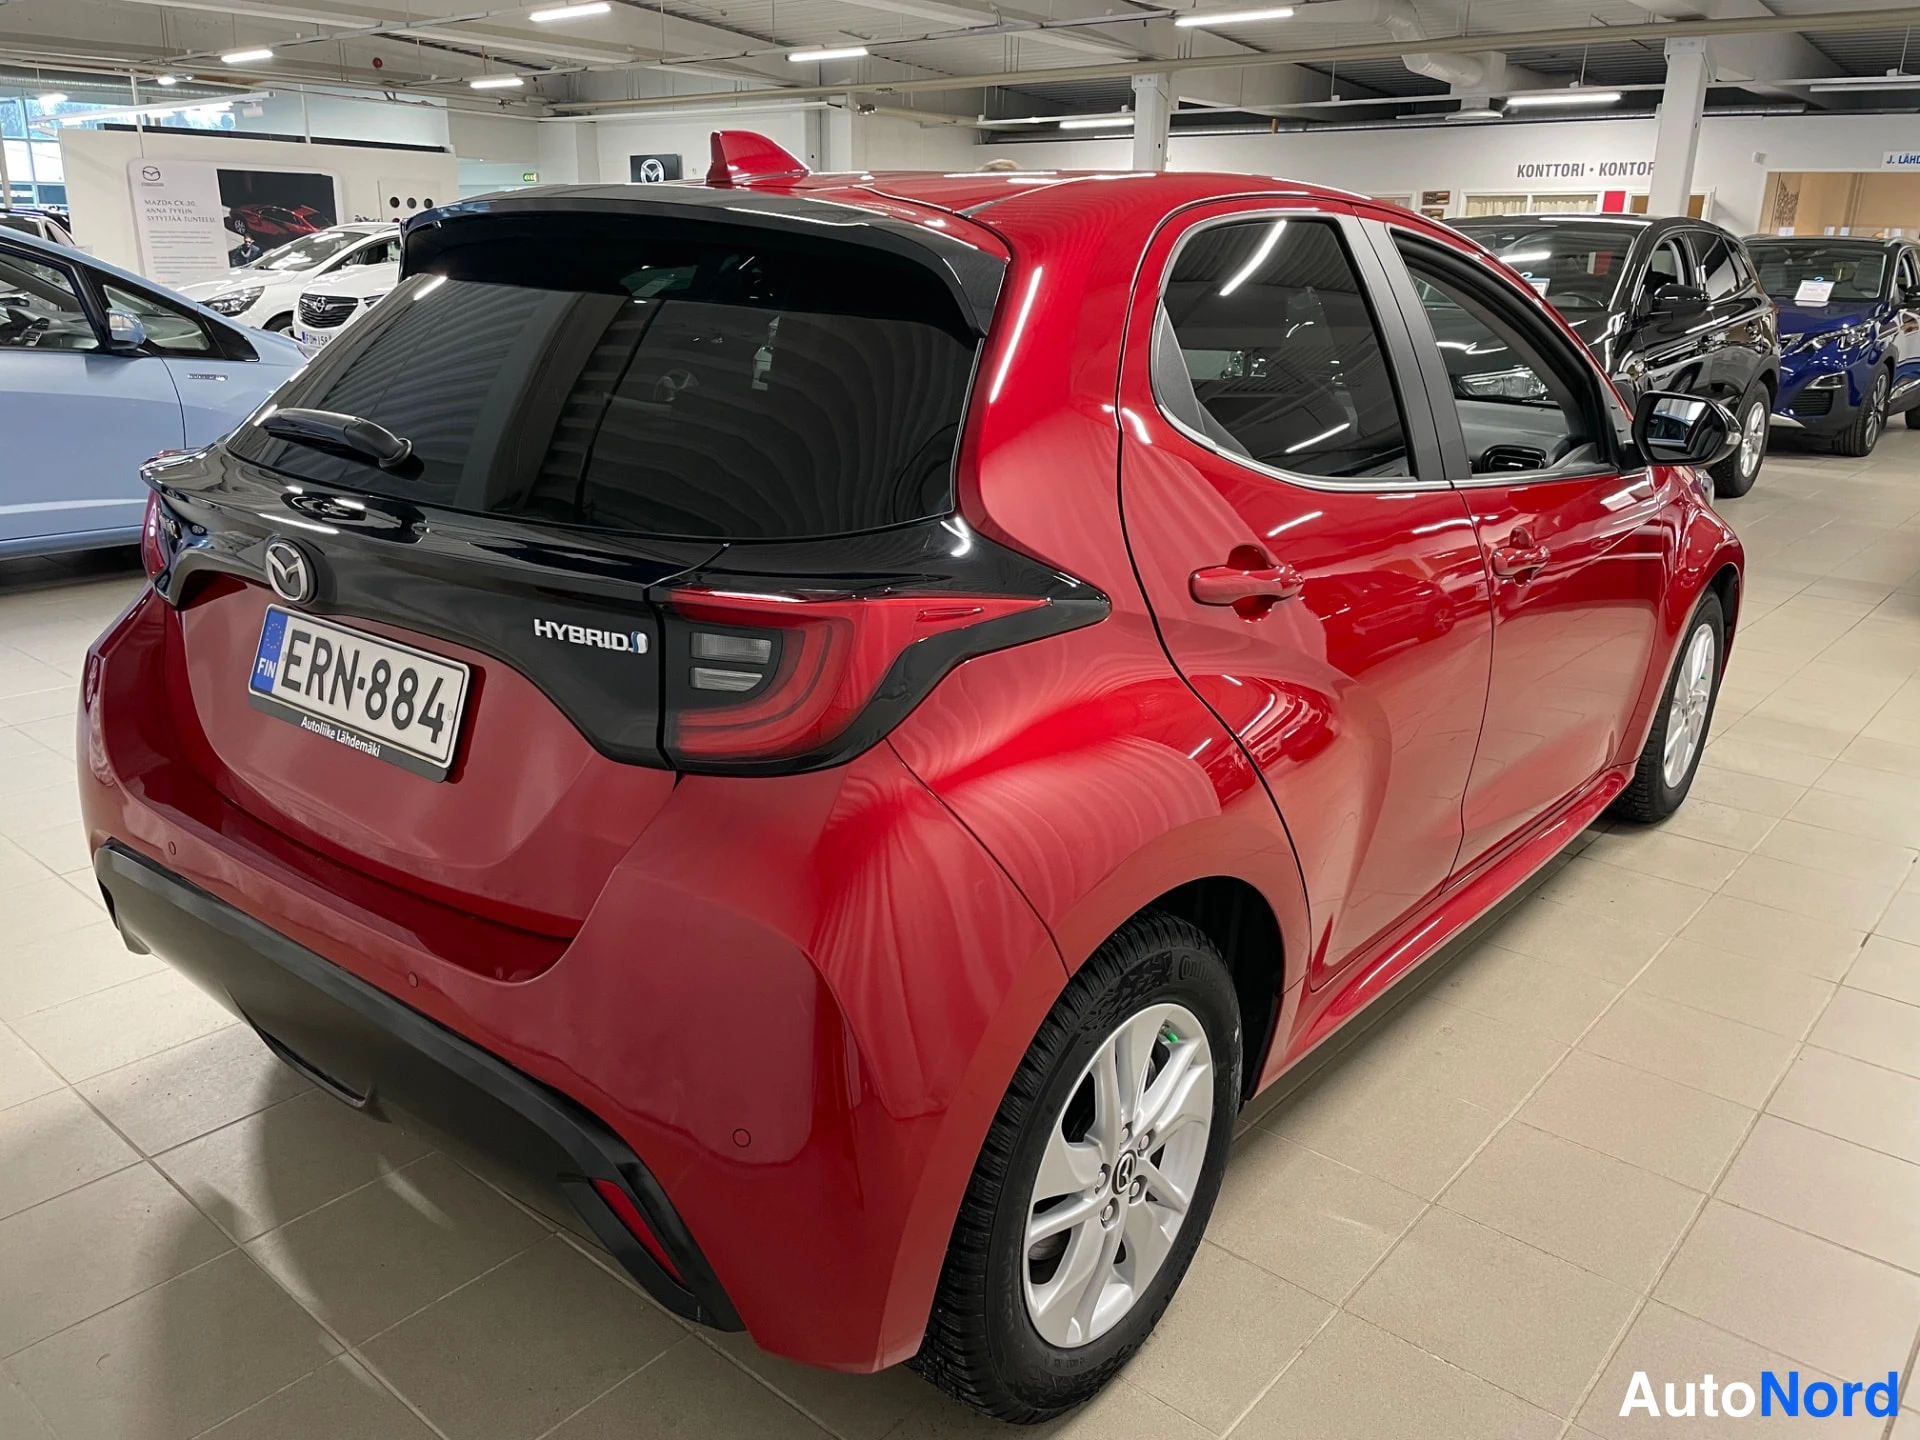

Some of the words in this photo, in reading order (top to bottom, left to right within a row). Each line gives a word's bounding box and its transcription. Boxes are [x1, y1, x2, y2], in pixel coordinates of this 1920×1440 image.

[1517, 163, 1585, 177] KONTTORI
[1886, 154, 1895, 164] J.
[533, 618, 630, 652] HYBRID
[256, 656, 277, 680] FIN
[280, 629, 446, 744] ERN-884
[300, 715, 336, 741] Autoliike
[336, 727, 381, 759] Lähdemäki
